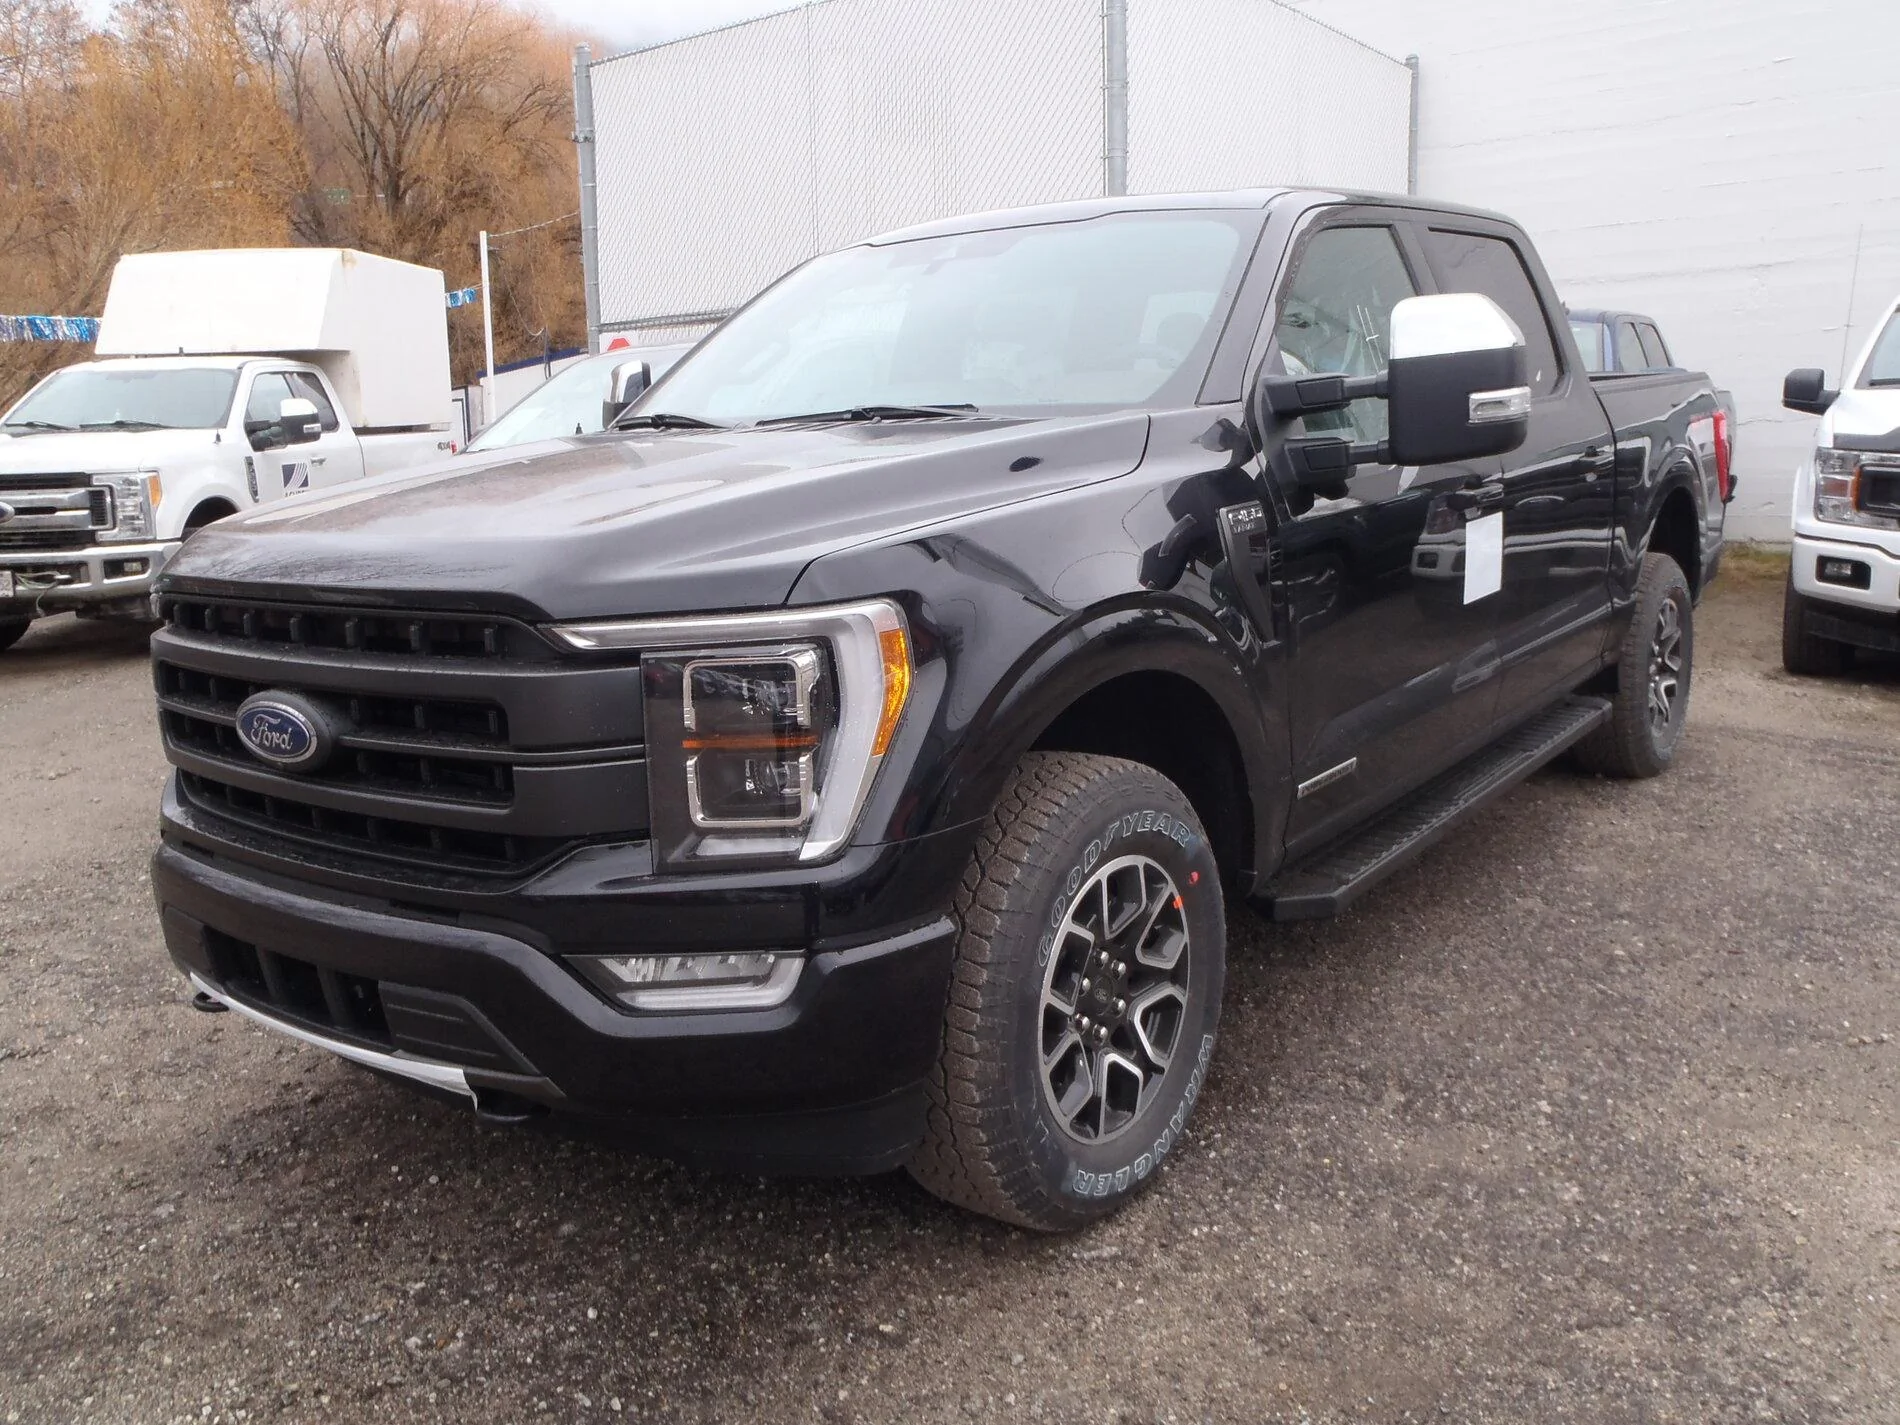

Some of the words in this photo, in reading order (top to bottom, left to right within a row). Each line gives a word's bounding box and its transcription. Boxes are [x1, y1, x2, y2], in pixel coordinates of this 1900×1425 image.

[251, 713, 294, 750] Ford
[1038, 810, 1192, 968] GOODYEAR
[1072, 1034, 1214, 1196] WRANGLER
